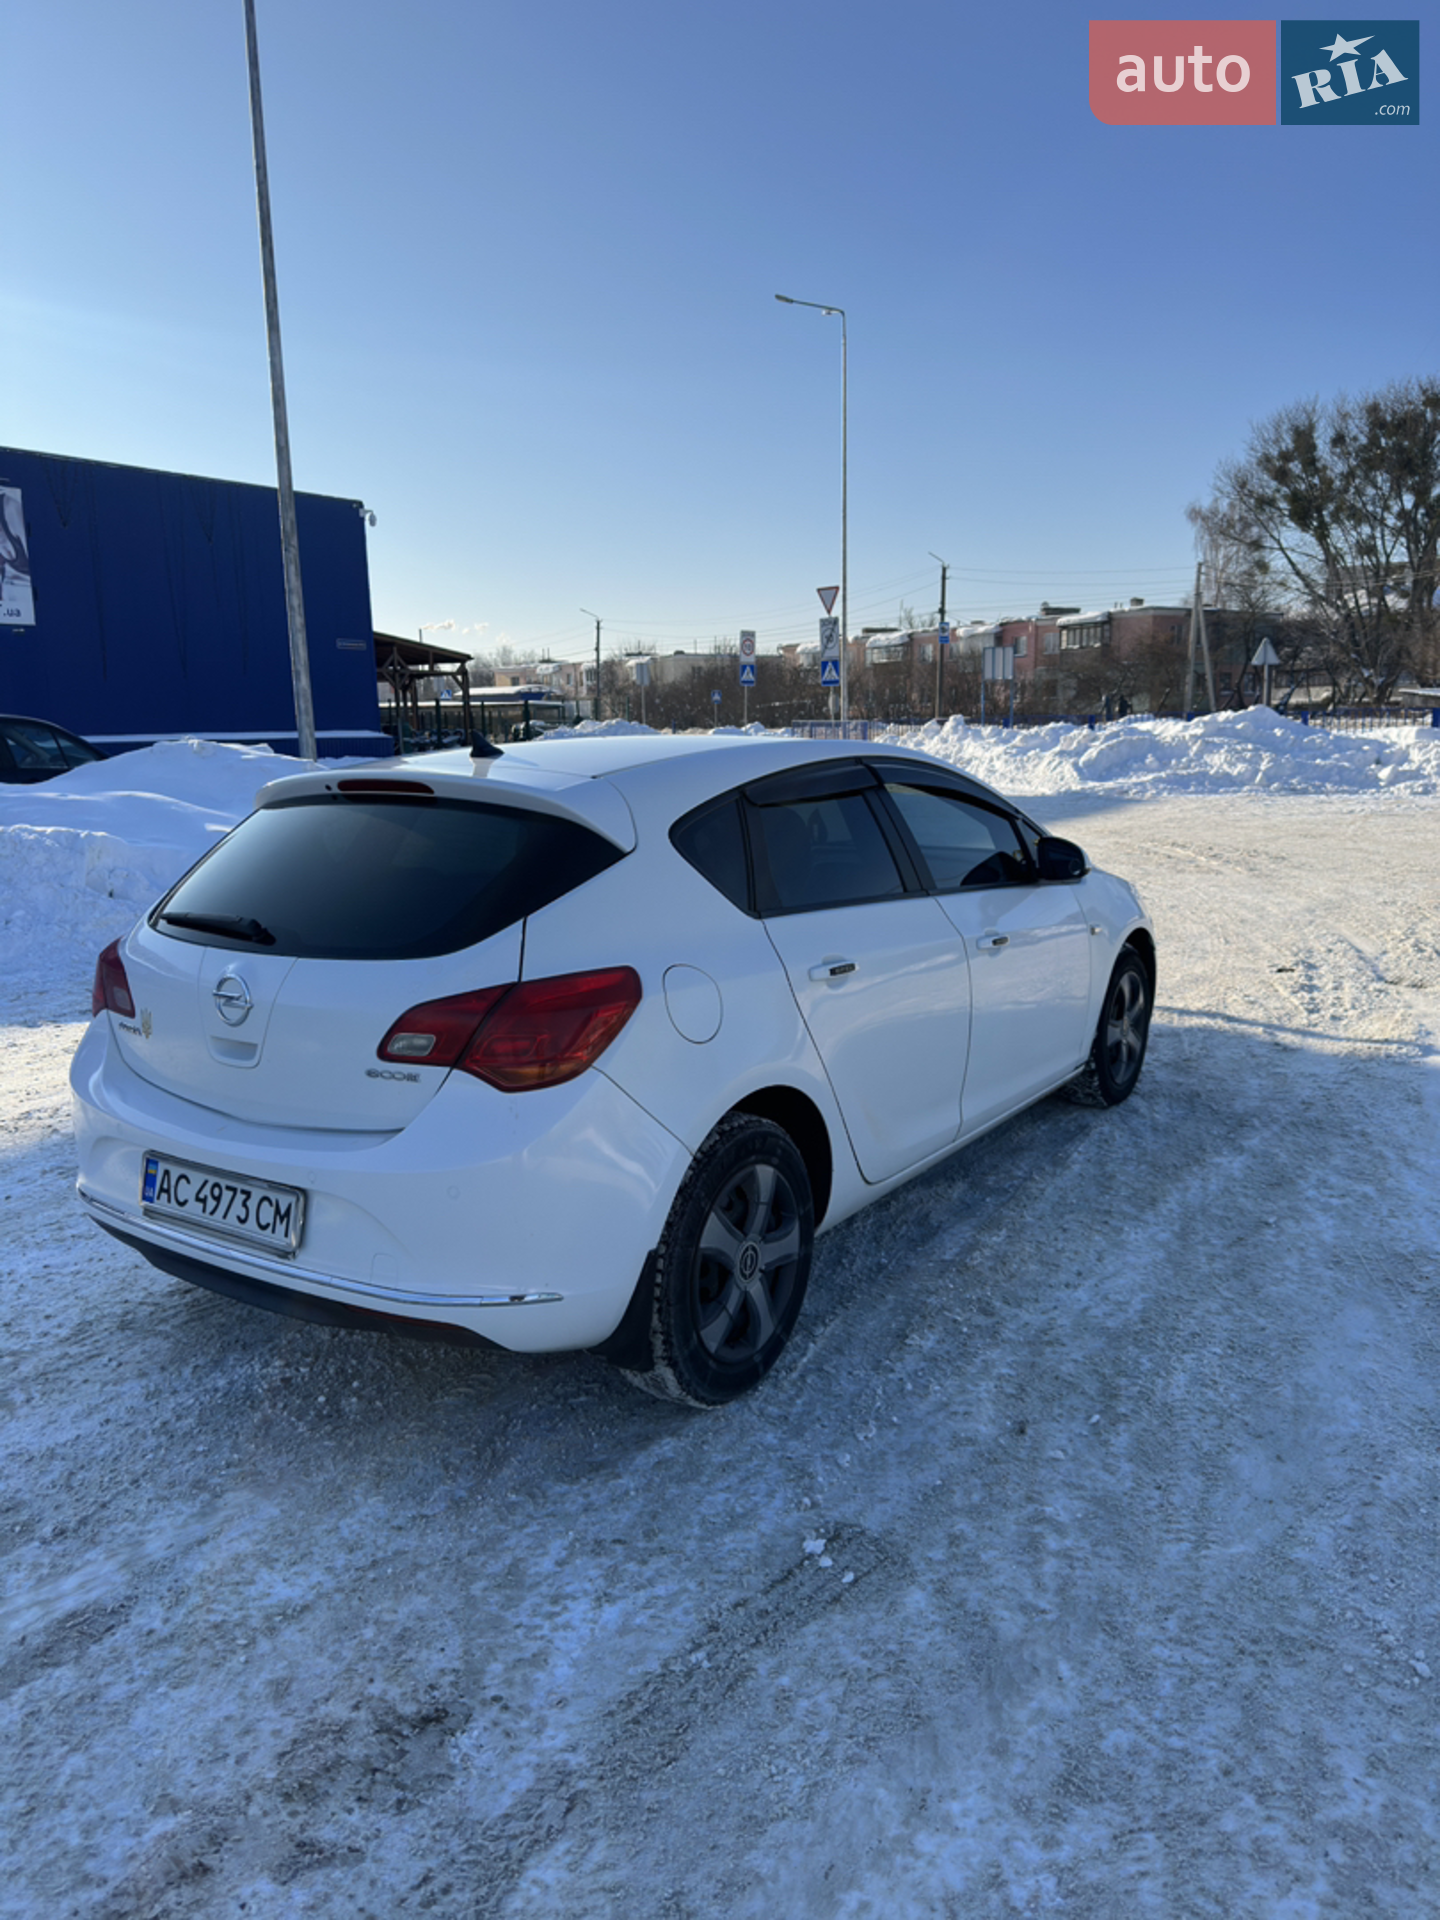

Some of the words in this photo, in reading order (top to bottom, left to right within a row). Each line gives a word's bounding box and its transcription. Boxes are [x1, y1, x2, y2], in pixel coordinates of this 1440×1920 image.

[156, 1169, 191, 1207] AC
[195, 1179, 251, 1224] 4973
[256, 1196, 292, 1238] CM
